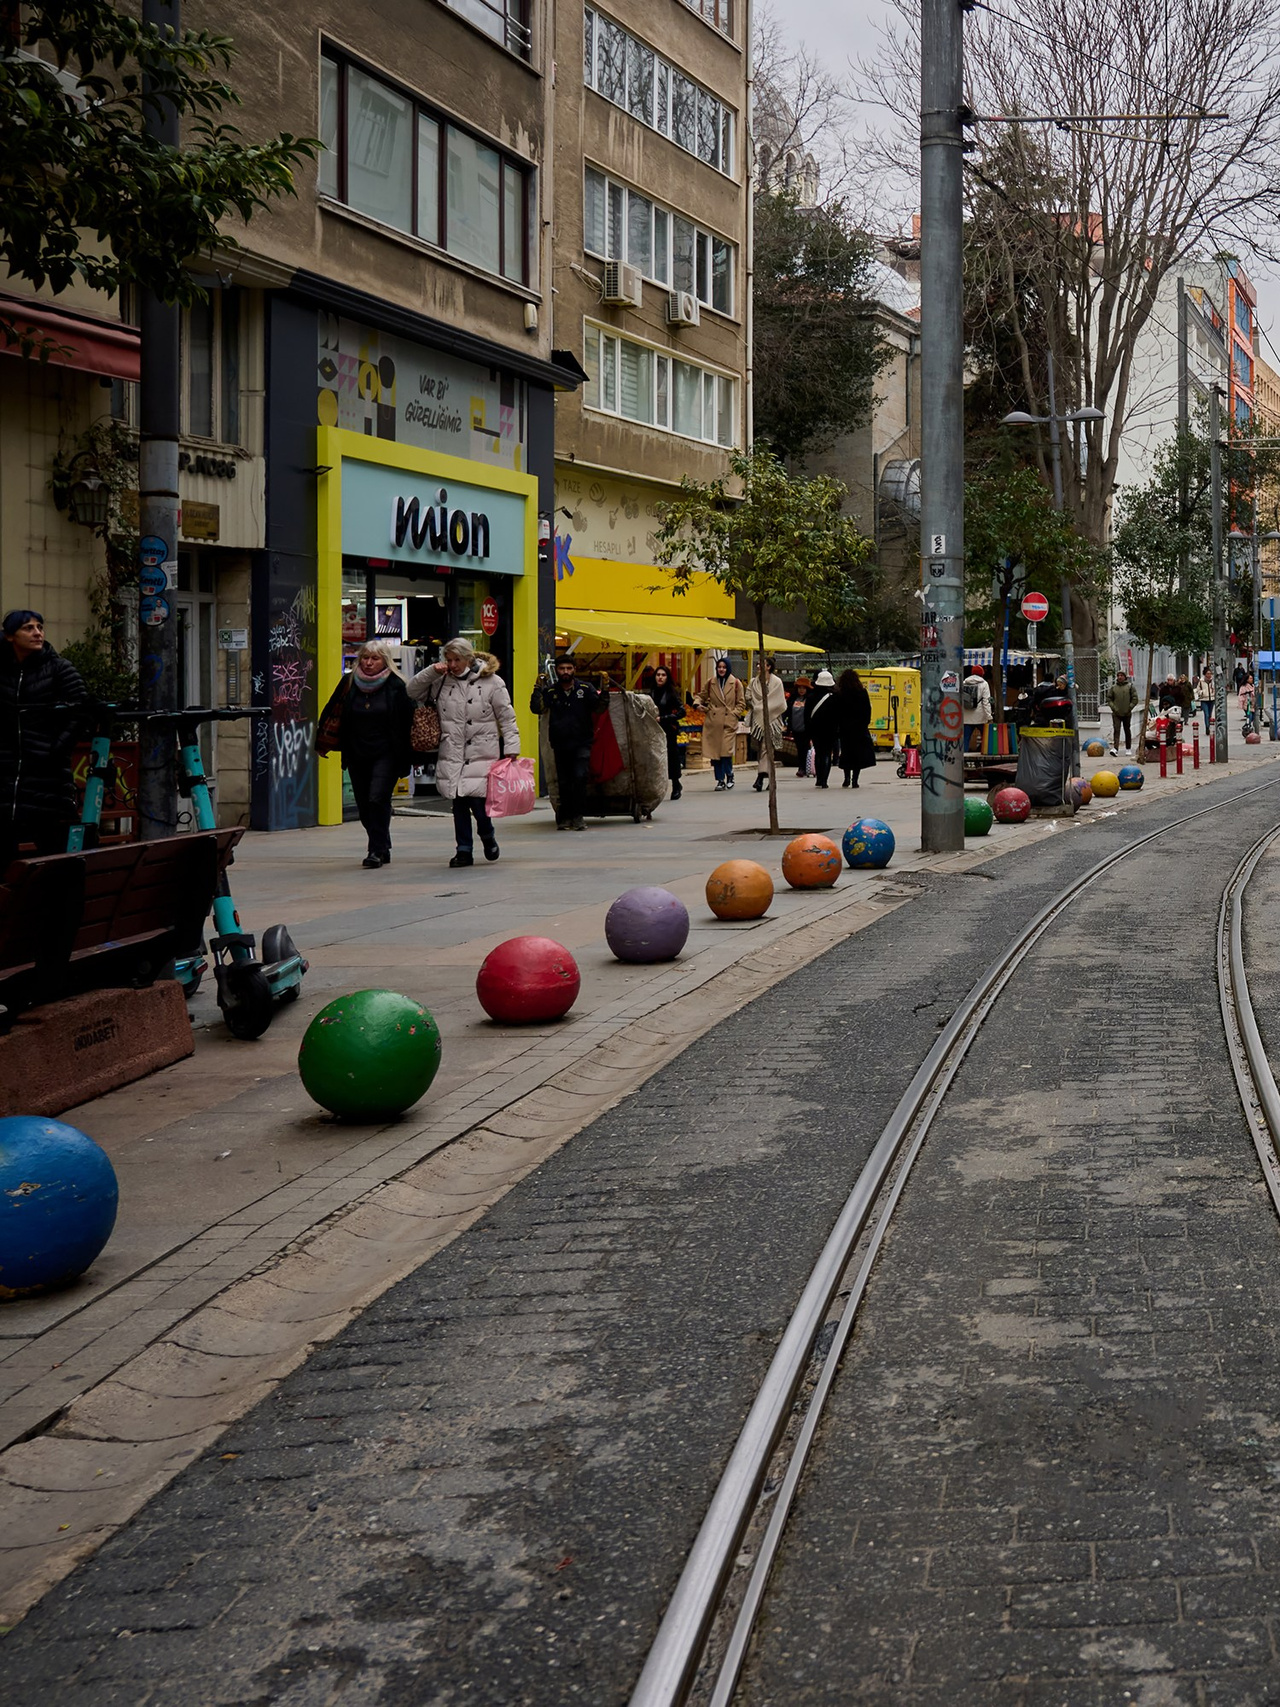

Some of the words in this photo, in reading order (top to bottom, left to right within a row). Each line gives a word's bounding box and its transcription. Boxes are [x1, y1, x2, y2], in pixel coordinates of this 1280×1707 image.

[419, 374, 435, 398] VAR
[405, 399, 462, 433] GÜZELLİĞİMİZ
[564, 479, 581, 494] TAZE
[390, 487, 490, 558] mion
